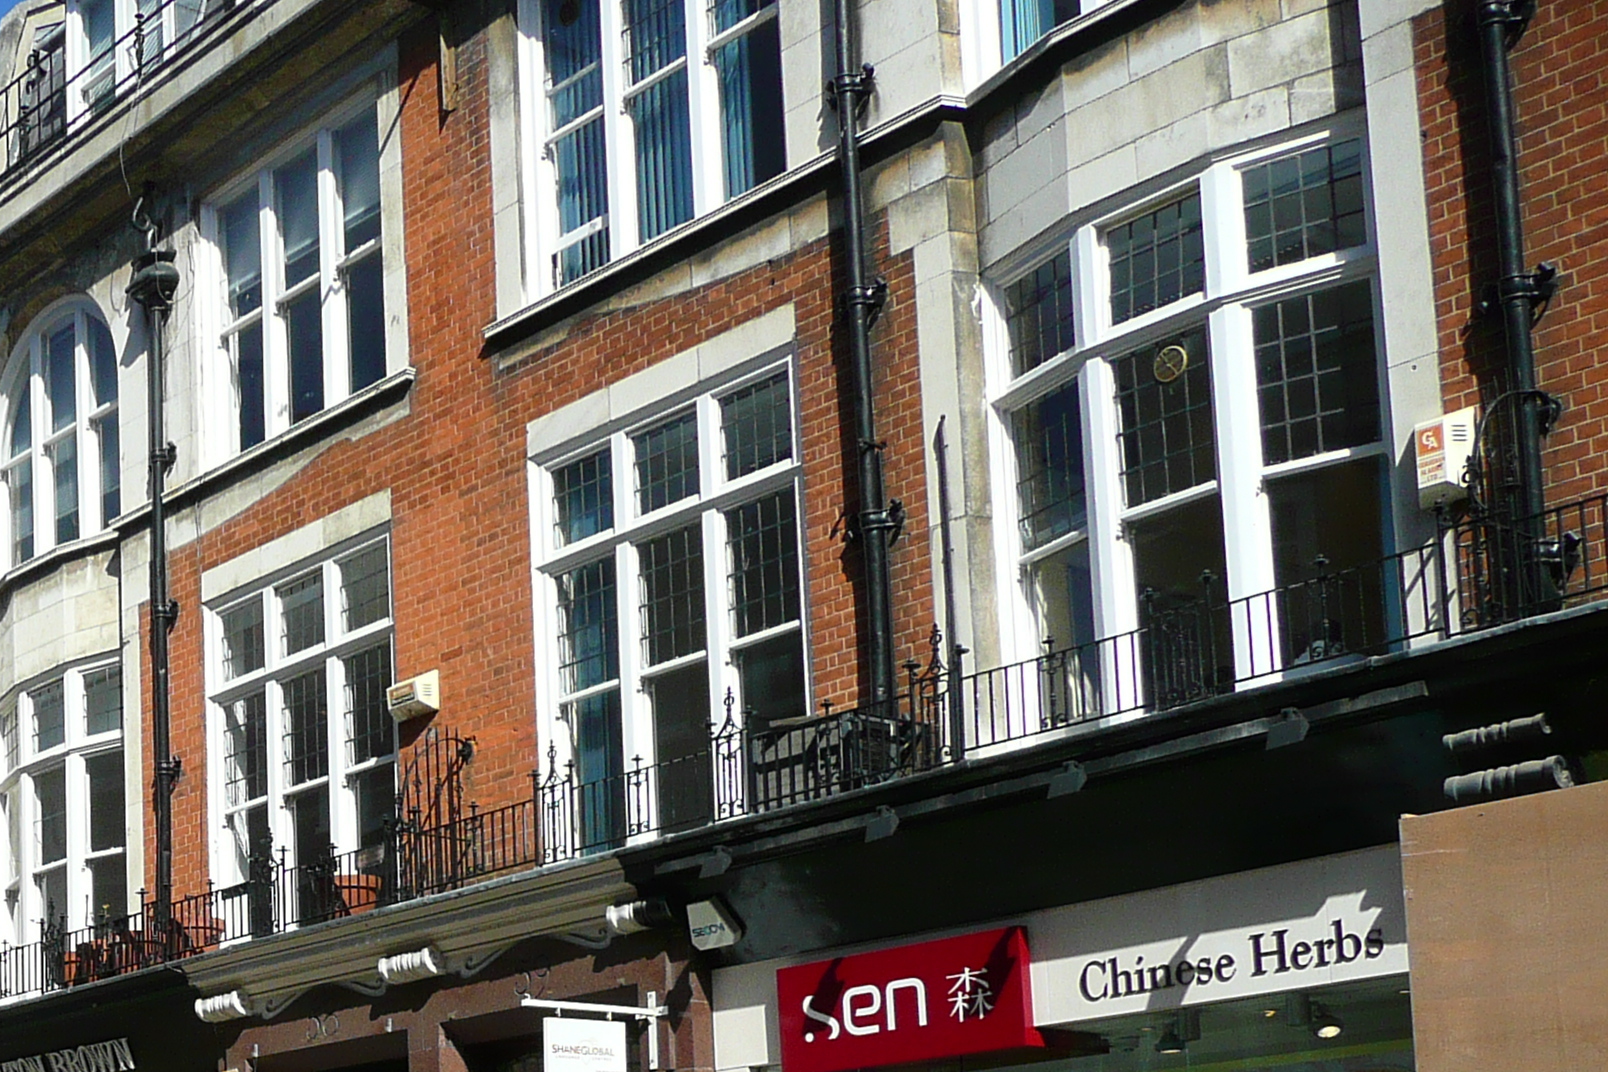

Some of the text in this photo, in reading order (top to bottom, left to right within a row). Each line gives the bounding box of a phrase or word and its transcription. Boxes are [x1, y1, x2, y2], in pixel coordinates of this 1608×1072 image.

[692, 922, 726, 938] SECOM
[1079, 919, 1385, 1002] Chinese Herbs
[946, 967, 993, 1023] 森
